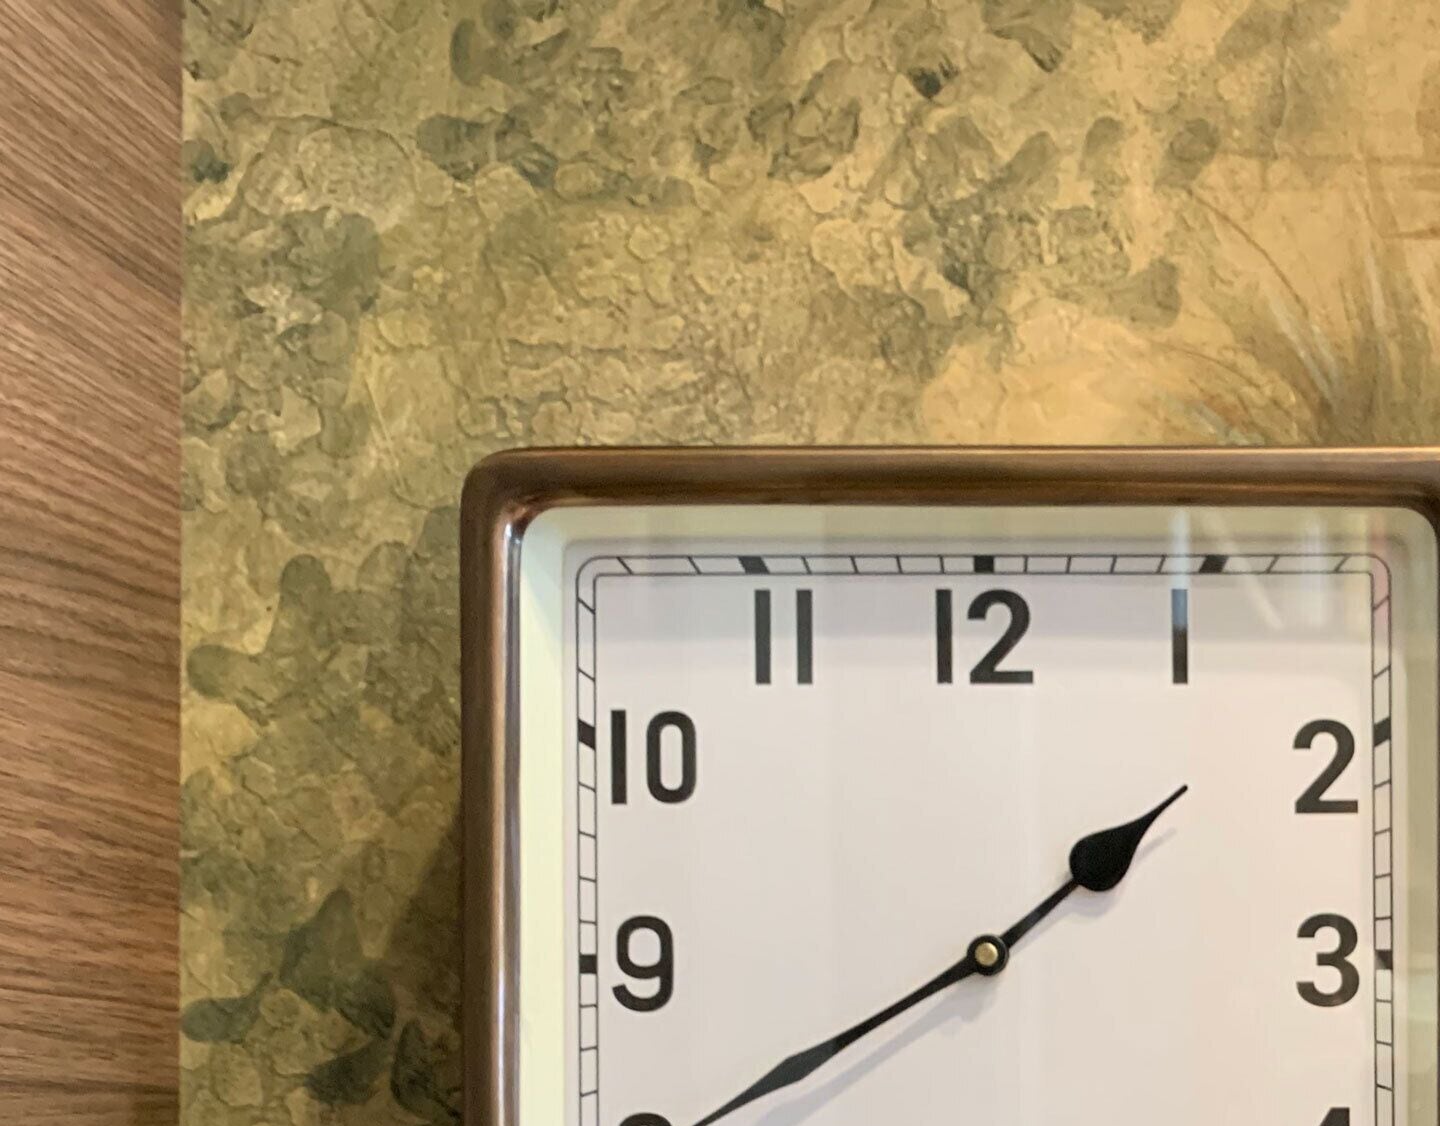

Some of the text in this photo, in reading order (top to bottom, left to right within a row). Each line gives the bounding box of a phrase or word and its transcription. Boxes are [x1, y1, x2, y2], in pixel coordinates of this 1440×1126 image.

[754, 589, 813, 684] 11
[935, 588, 1034, 684] 12
[1172, 588, 1189, 684] 1
[610, 709, 697, 805] 10
[1293, 719, 1359, 814] 2
[611, 915, 675, 1012] 9
[1296, 913, 1360, 1007] 3
